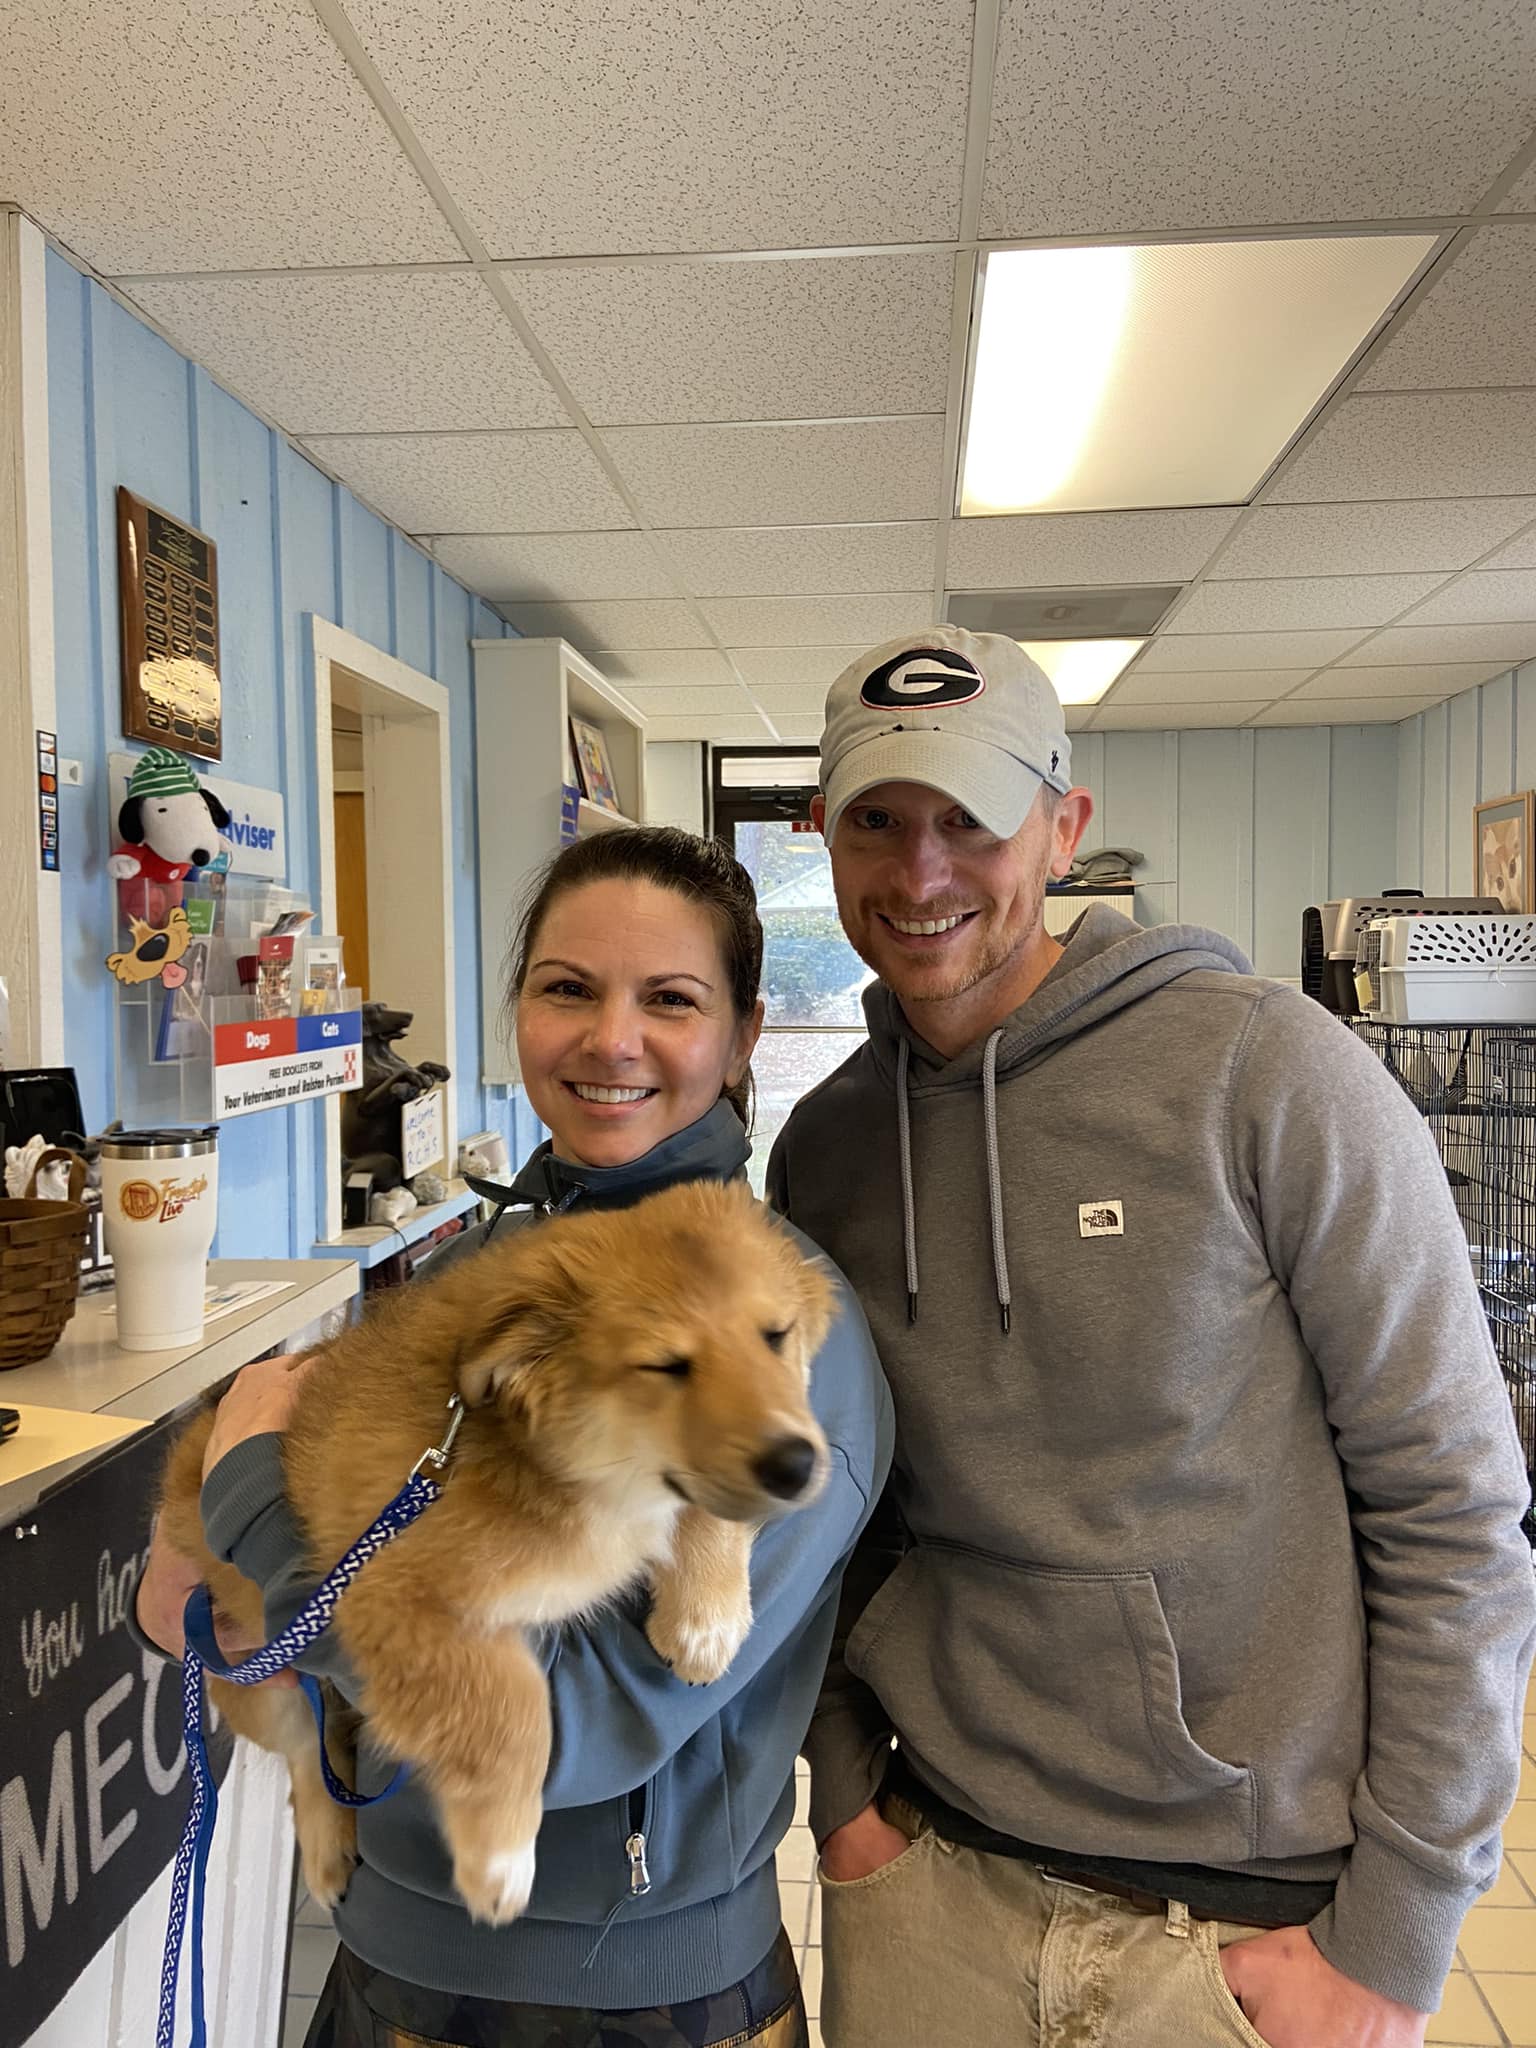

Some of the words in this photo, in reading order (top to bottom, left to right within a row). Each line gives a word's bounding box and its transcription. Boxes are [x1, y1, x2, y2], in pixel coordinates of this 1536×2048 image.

[860, 647, 985, 710] G
[218, 809, 276, 851] dviser
[800, 822, 817, 831] EX
[246, 1030, 270, 1051] Dogs
[322, 1021, 339, 1038] Cats
[269, 1067, 281, 1079] FREE
[282, 1062, 308, 1076] BOOKLETS
[309, 1060, 323, 1071] FROM
[224, 1094, 242, 1110] Your
[243, 1084, 286, 1106] Veterinarian
[288, 1080, 301, 1095] and
[302, 1077, 325, 1092] Ralston
[159, 1200, 185, 1223] Live
